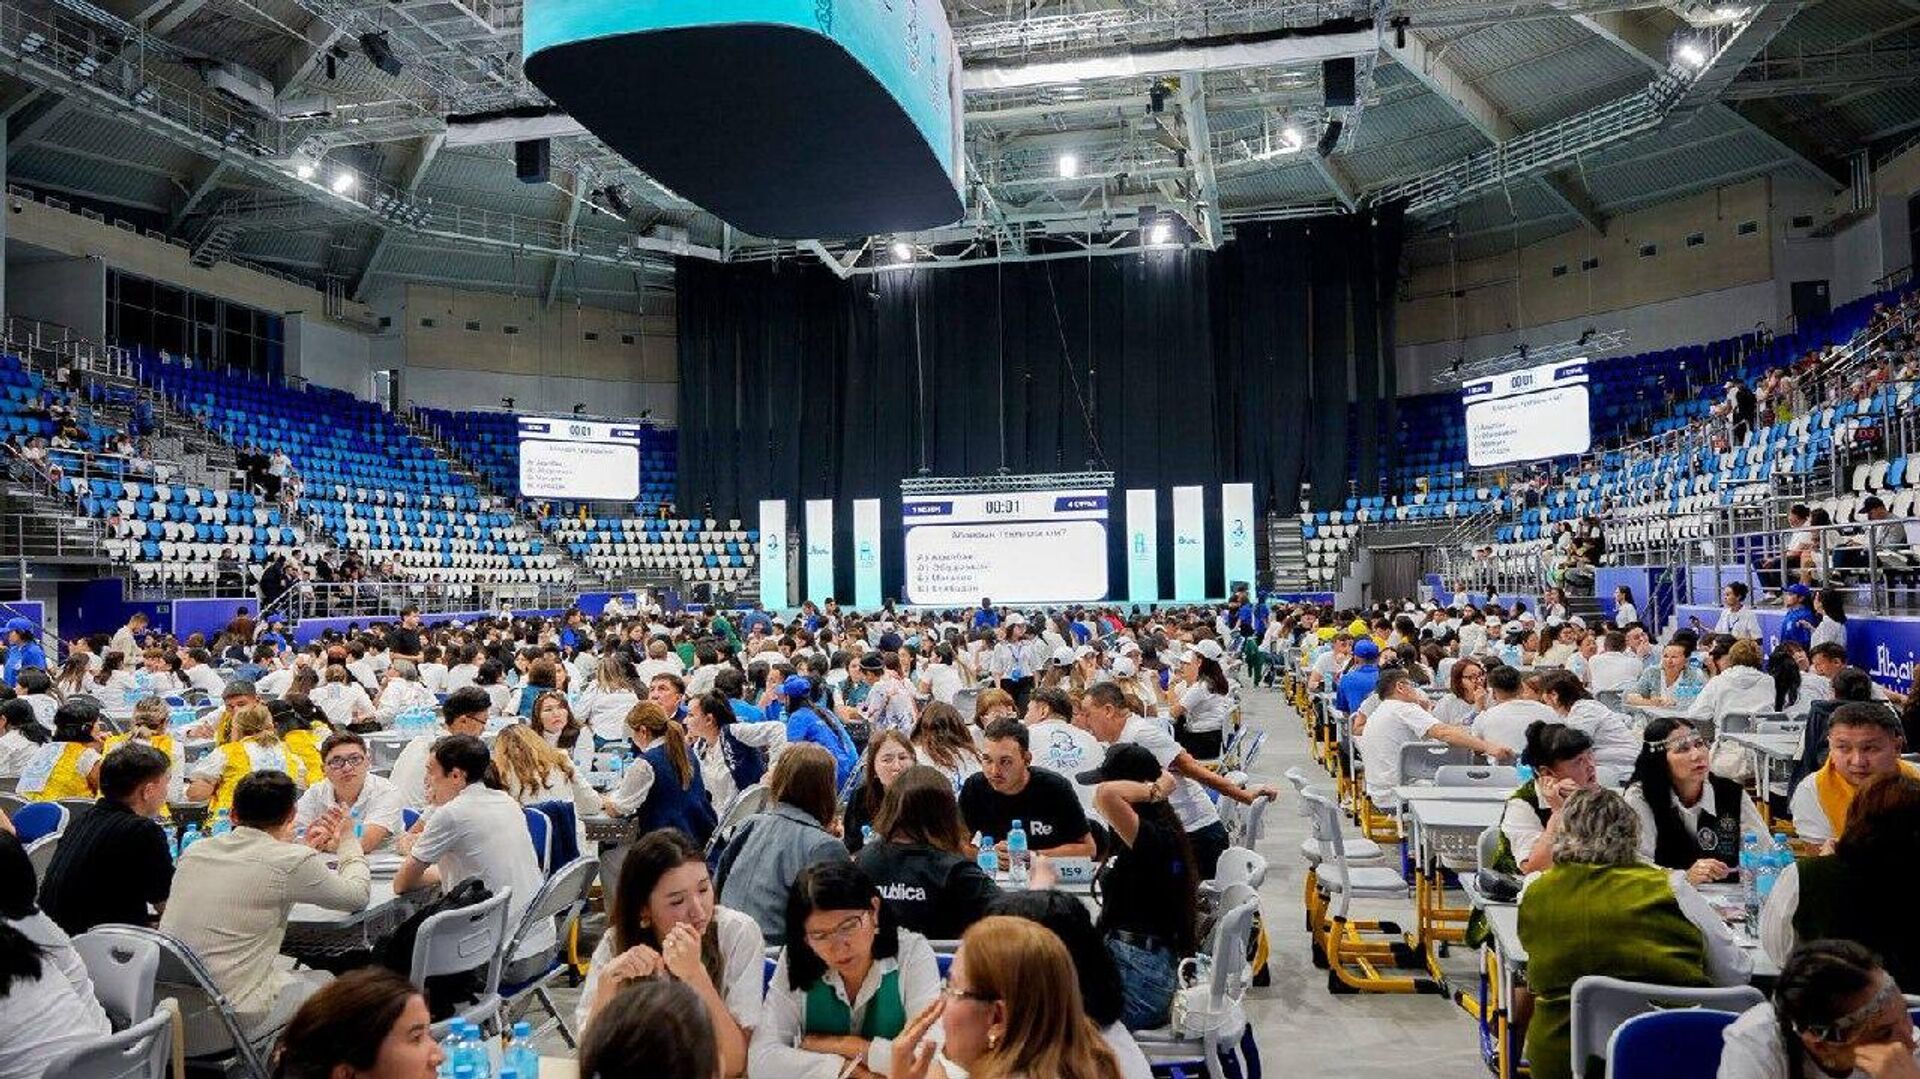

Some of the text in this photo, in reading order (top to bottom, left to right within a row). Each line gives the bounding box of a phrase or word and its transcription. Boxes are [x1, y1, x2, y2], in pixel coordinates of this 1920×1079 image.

[986, 500, 1020, 514] 00:01
[1030, 820, 1053, 836] Re
[1060, 867, 1082, 877] 159
